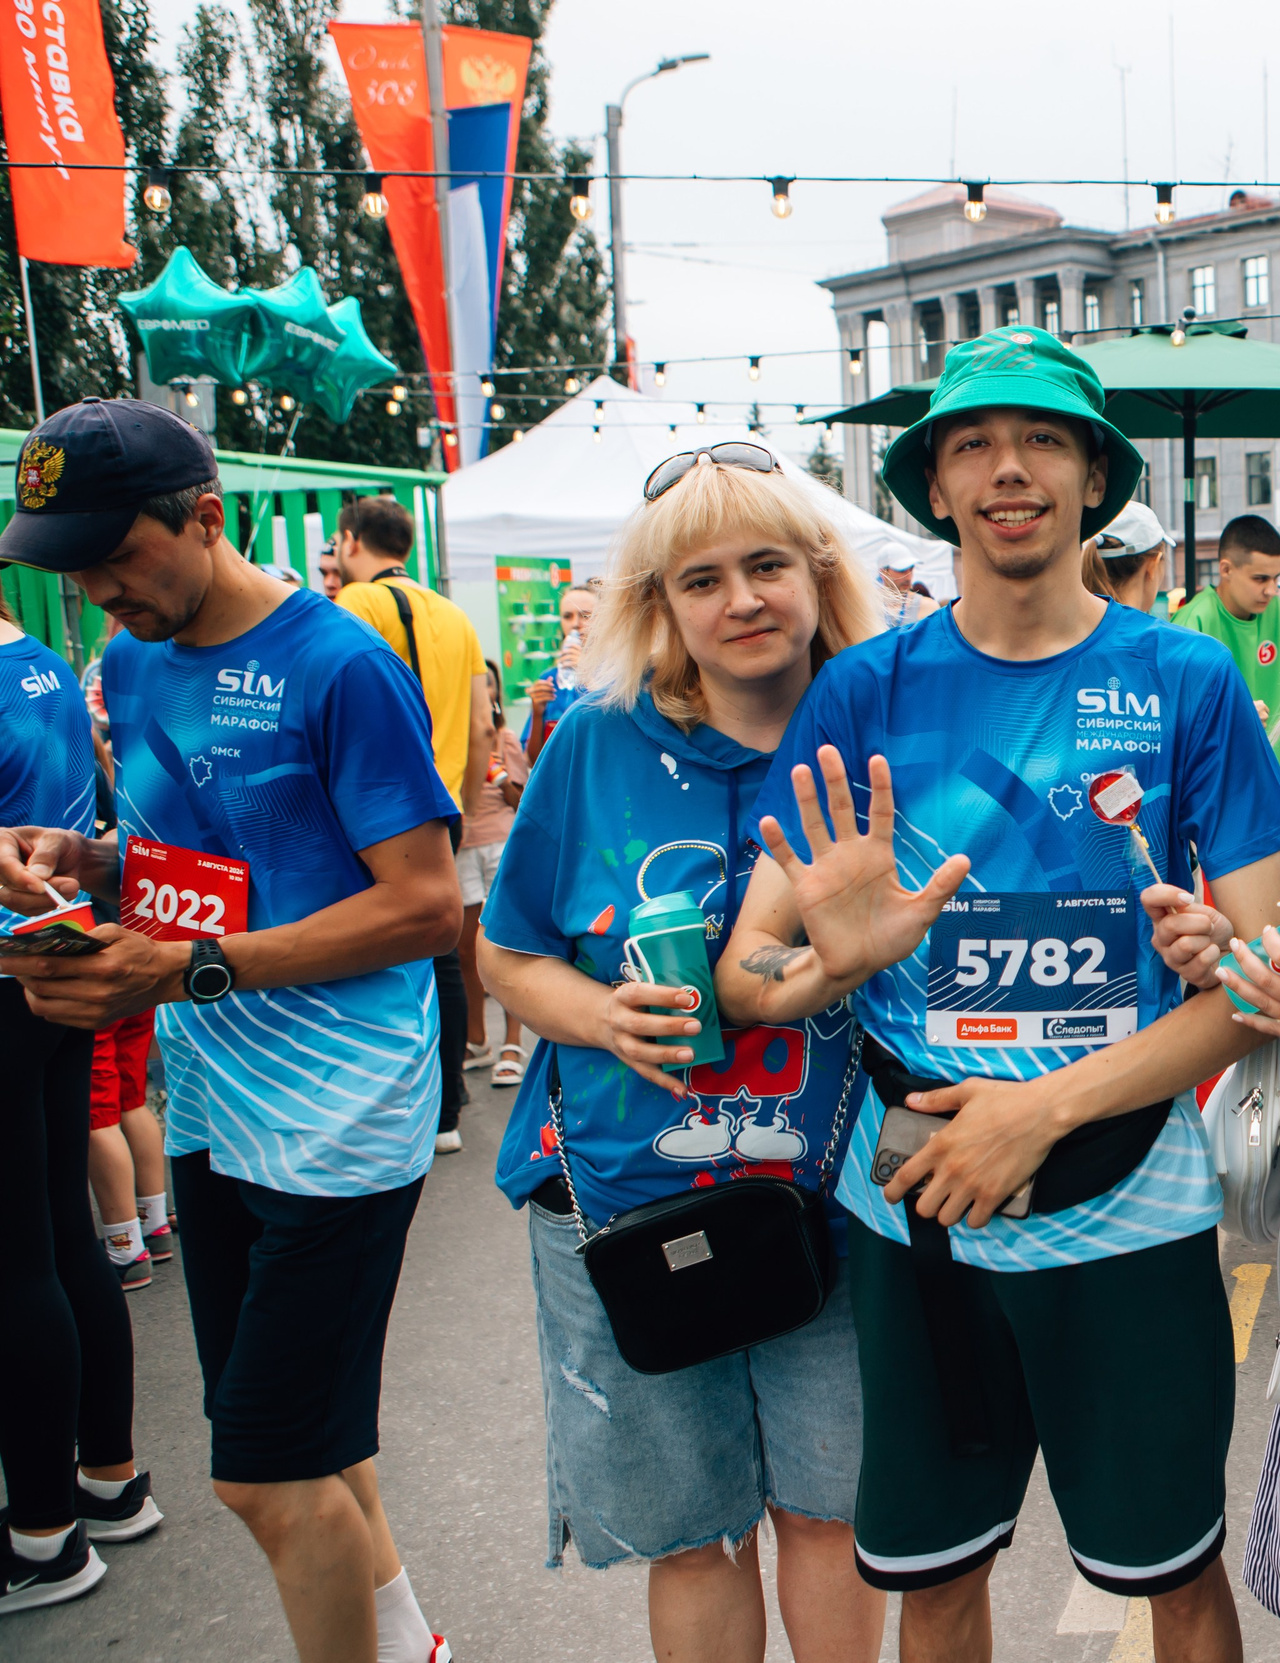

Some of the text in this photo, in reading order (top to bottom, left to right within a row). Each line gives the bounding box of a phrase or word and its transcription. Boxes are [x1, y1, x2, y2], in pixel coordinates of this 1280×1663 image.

[42, 0, 85, 143] ставка
[210, 714, 279, 733] МАРАФОН
[1076, 718, 1161, 732] СИБИРСКИЙ
[1076, 730, 1161, 741] МЕЖДУНАРОДНЫЙ
[211, 746, 241, 758] ОМСК
[1076, 738, 1161, 754] МАРАФОН
[202, 861, 228, 872] АВГУСТА
[134, 878, 225, 935] 2022
[1056, 898, 1127, 908] 3 АВГУСТА 2024
[954, 936, 1108, 987] 5782
[961, 1024, 1012, 1036] Альфа Банк
[1053, 1024, 1104, 1035] Следопыт
